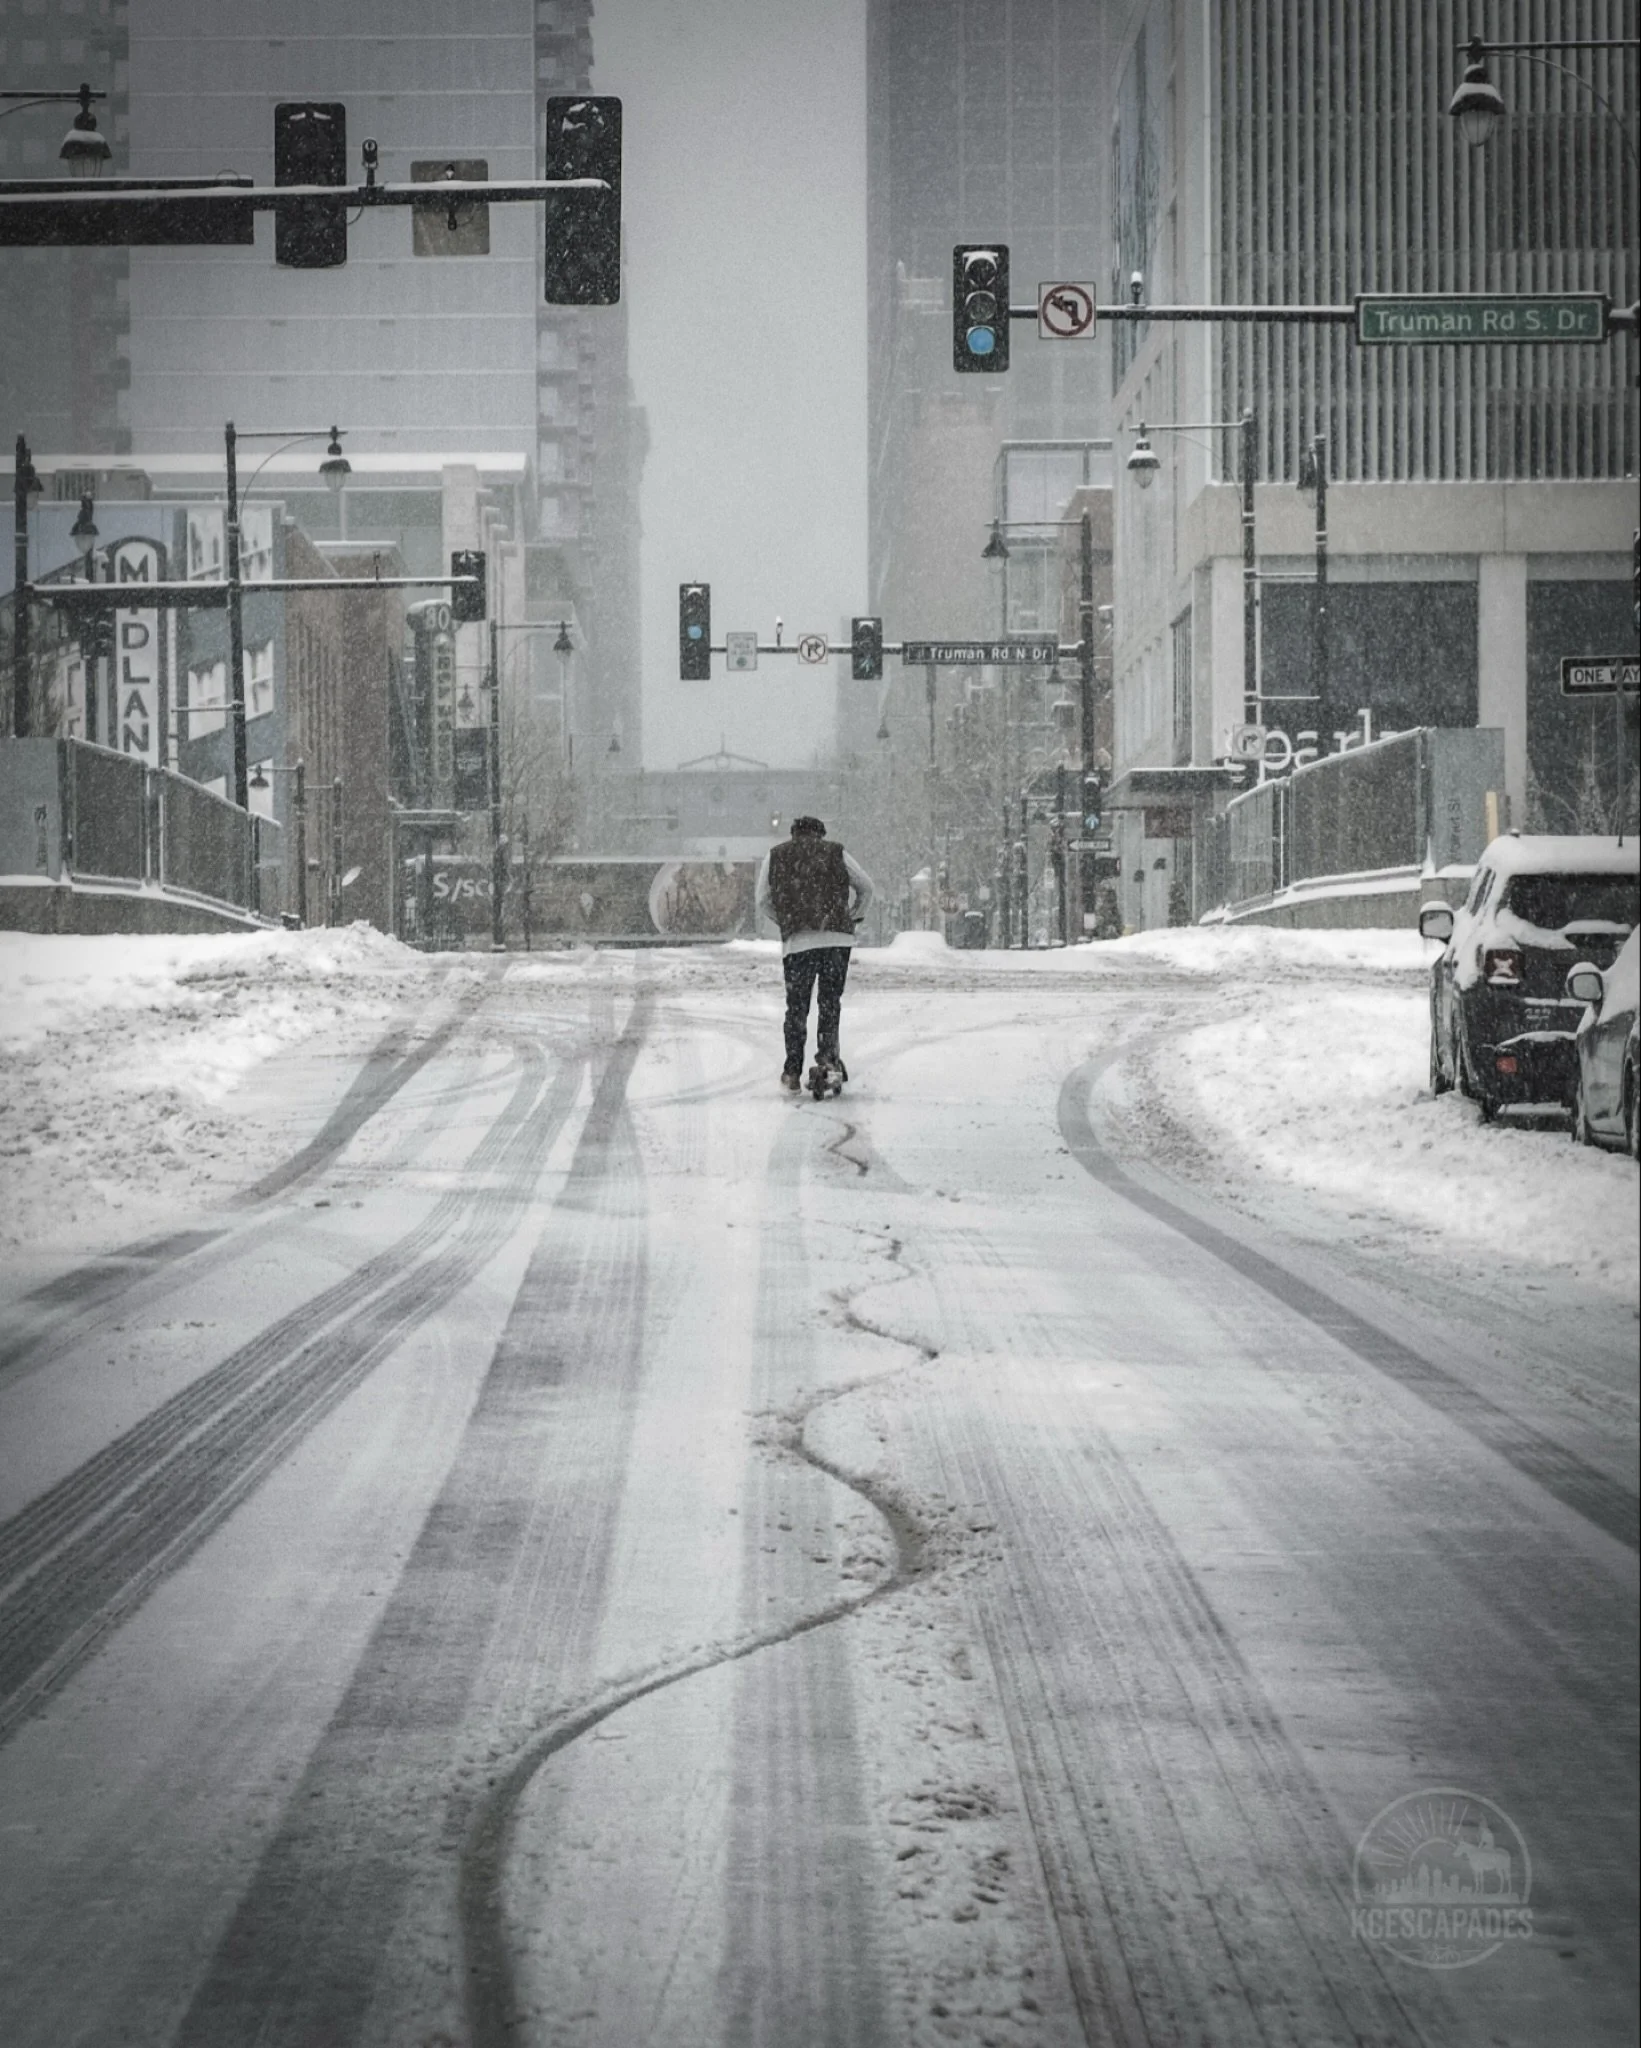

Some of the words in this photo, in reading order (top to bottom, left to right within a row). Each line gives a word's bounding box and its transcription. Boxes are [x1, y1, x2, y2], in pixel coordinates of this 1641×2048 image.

[1375, 310, 1472, 333] Truman
[1483, 309, 1516, 331] Rd
[1526, 309, 1549, 331] S.
[1557, 308, 1588, 331] Dr
[119, 555, 150, 752] MDLAN
[930, 647, 985, 660] Truman
[991, 647, 1009, 660] Rd
[1016, 647, 1026, 659] N
[1032, 647, 1048, 660] Dr
[1574, 668, 1605, 683] ONE
